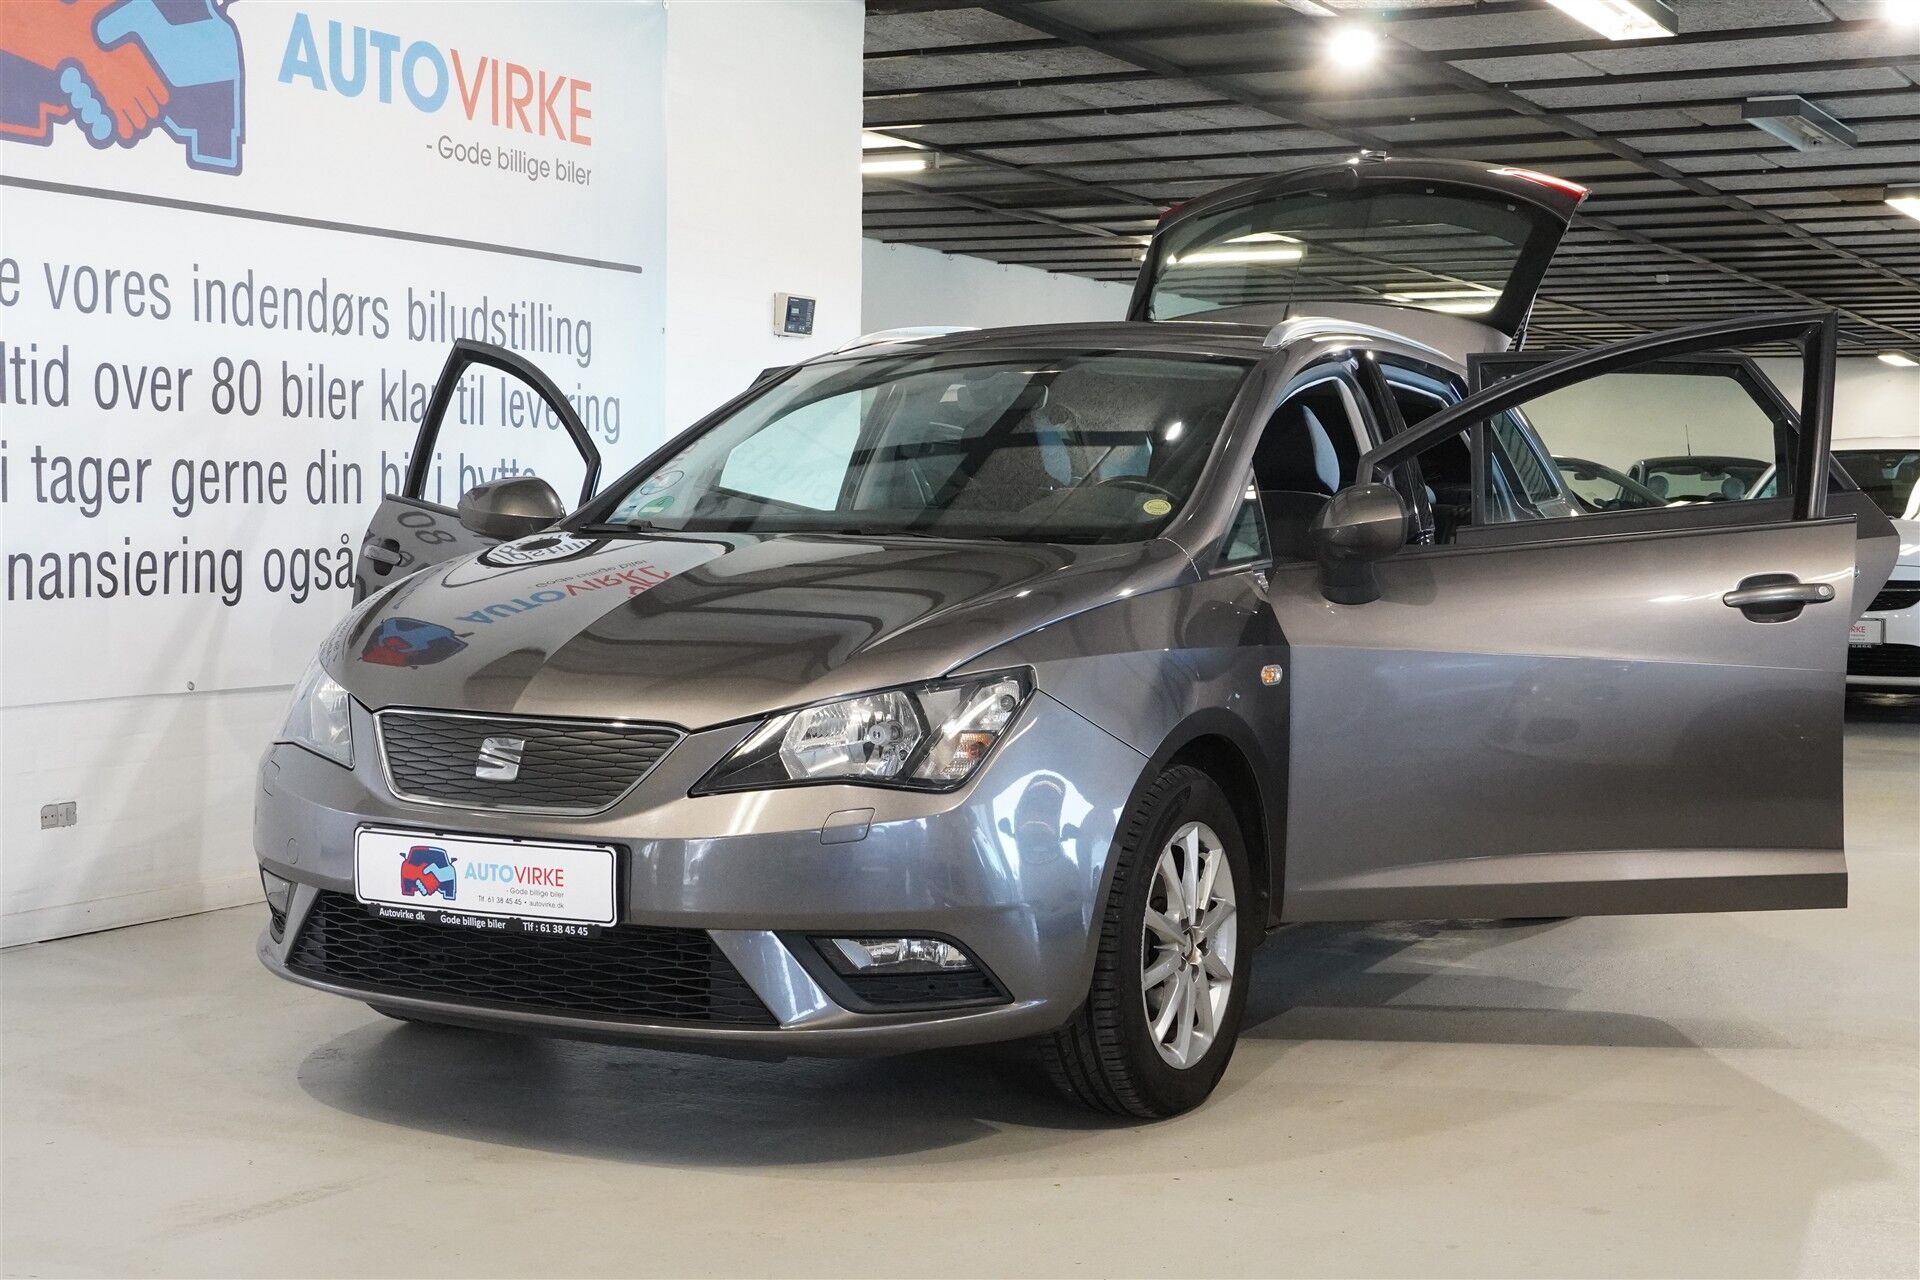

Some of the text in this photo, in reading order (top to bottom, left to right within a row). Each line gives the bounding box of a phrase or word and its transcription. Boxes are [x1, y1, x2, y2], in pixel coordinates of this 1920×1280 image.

[278, 12, 592, 146] AUTOVIRKE
[438, 135, 491, 166] Gode
[498, 147, 550, 181] billige
[556, 158, 592, 186] biler
[44, 263, 171, 320] vores
[193, 263, 389, 339] indendørs
[408, 287, 592, 368] biludstilling
[94, 362, 193, 412] over
[212, 357, 262, 416] 80
[282, 361, 364, 420] biler
[381, 368, 437, 424] kla
[457, 374, 484, 425] til
[31, 446, 152, 518] tager
[172, 459, 287, 518] gerne
[306, 449, 361, 504] din
[437, 452, 442, 504] i
[8, 534, 355, 606] nansiering også
[464, 862, 564, 887] AUTOVIRKE
[510, 887, 528, 895] Gode
[530, 889, 548, 898] billige
[514, 898, 522, 906] 45
[379, 907, 414, 920] Autovirke
[415, 911, 425, 920] dk
[440, 914, 460, 925] Gode
[462, 916, 486, 929] billige
[487, 918, 506, 929] biler
[523, 922, 534, 932] Tlf
[540, 923, 551, 933] 61
[552, 924, 563, 934] 38
[564, 925, 576, 935] 45
[577, 926, 588, 936] 45
